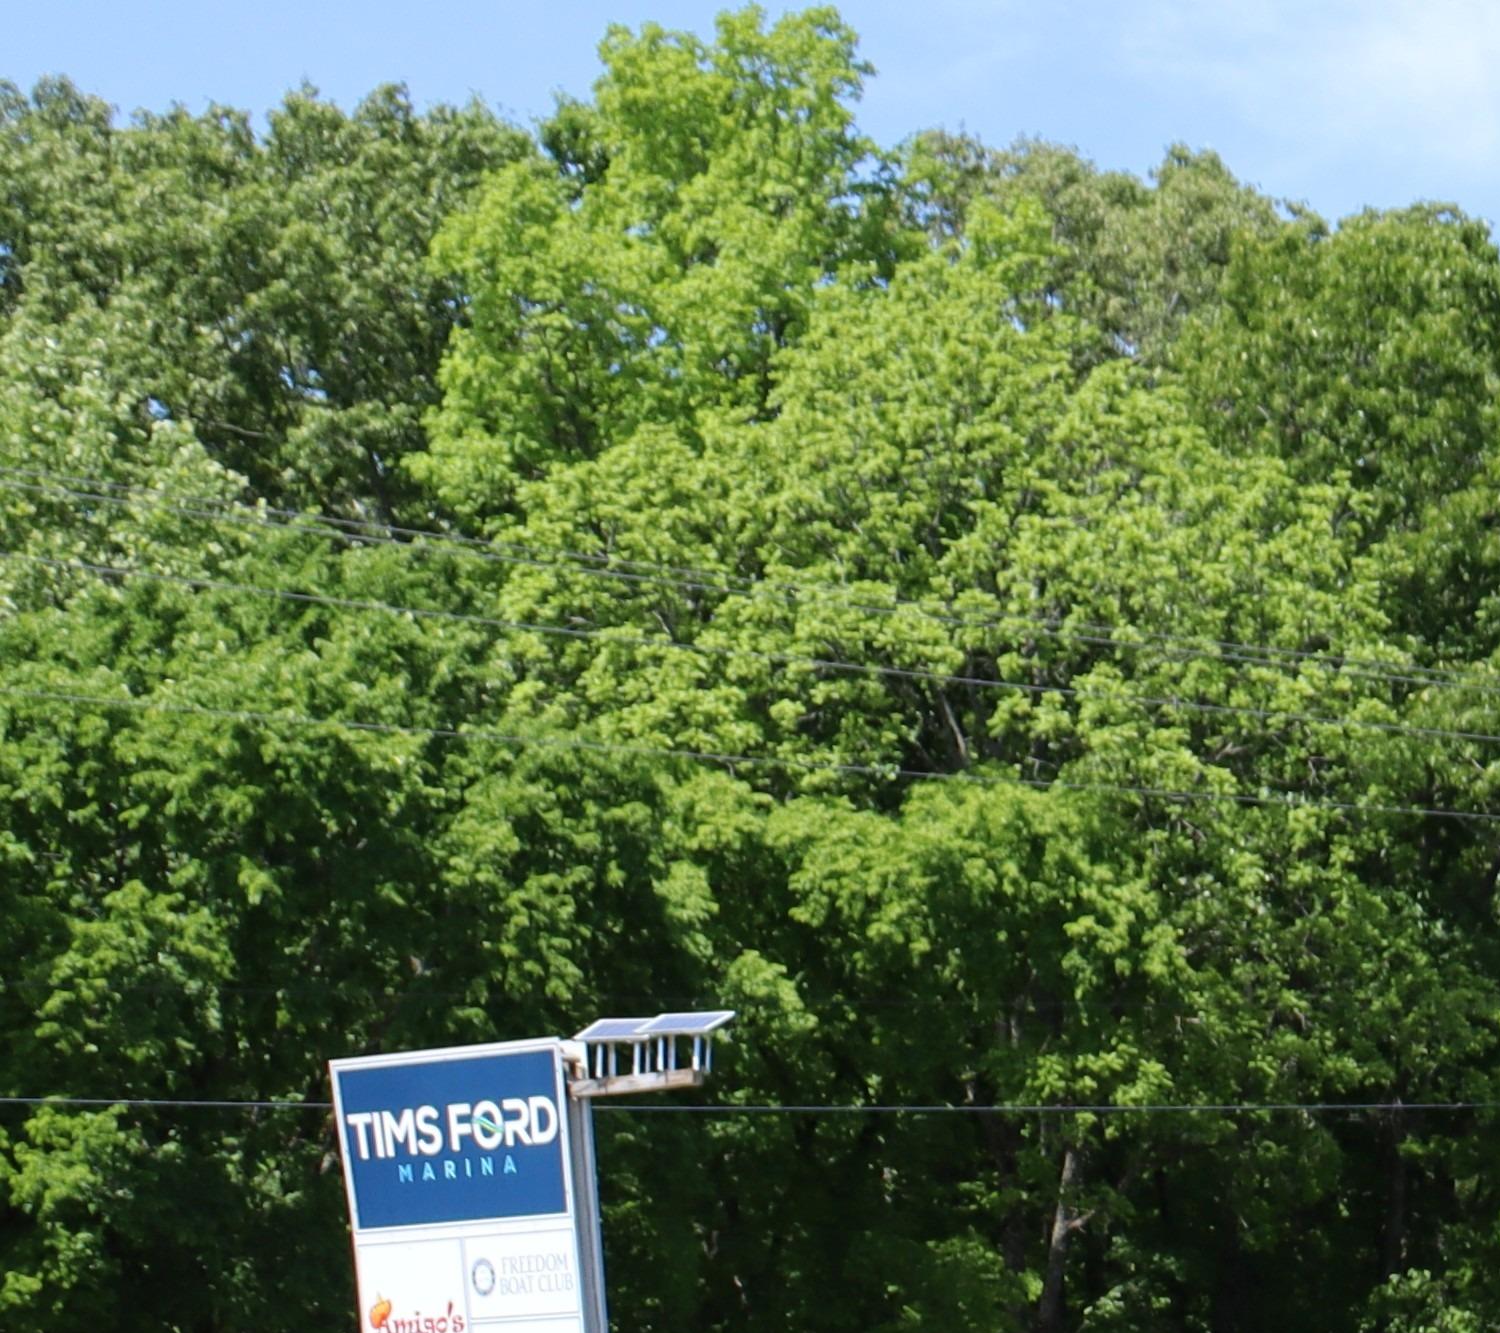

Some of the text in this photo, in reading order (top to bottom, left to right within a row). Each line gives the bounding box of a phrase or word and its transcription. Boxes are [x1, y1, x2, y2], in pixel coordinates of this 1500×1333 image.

[346, 1095, 558, 1160] TIMS FORD
[398, 1154, 517, 1183] MARINA
[501, 1252, 569, 1275] FREEDOM
[500, 1273, 574, 1296] BOAT CLUB
